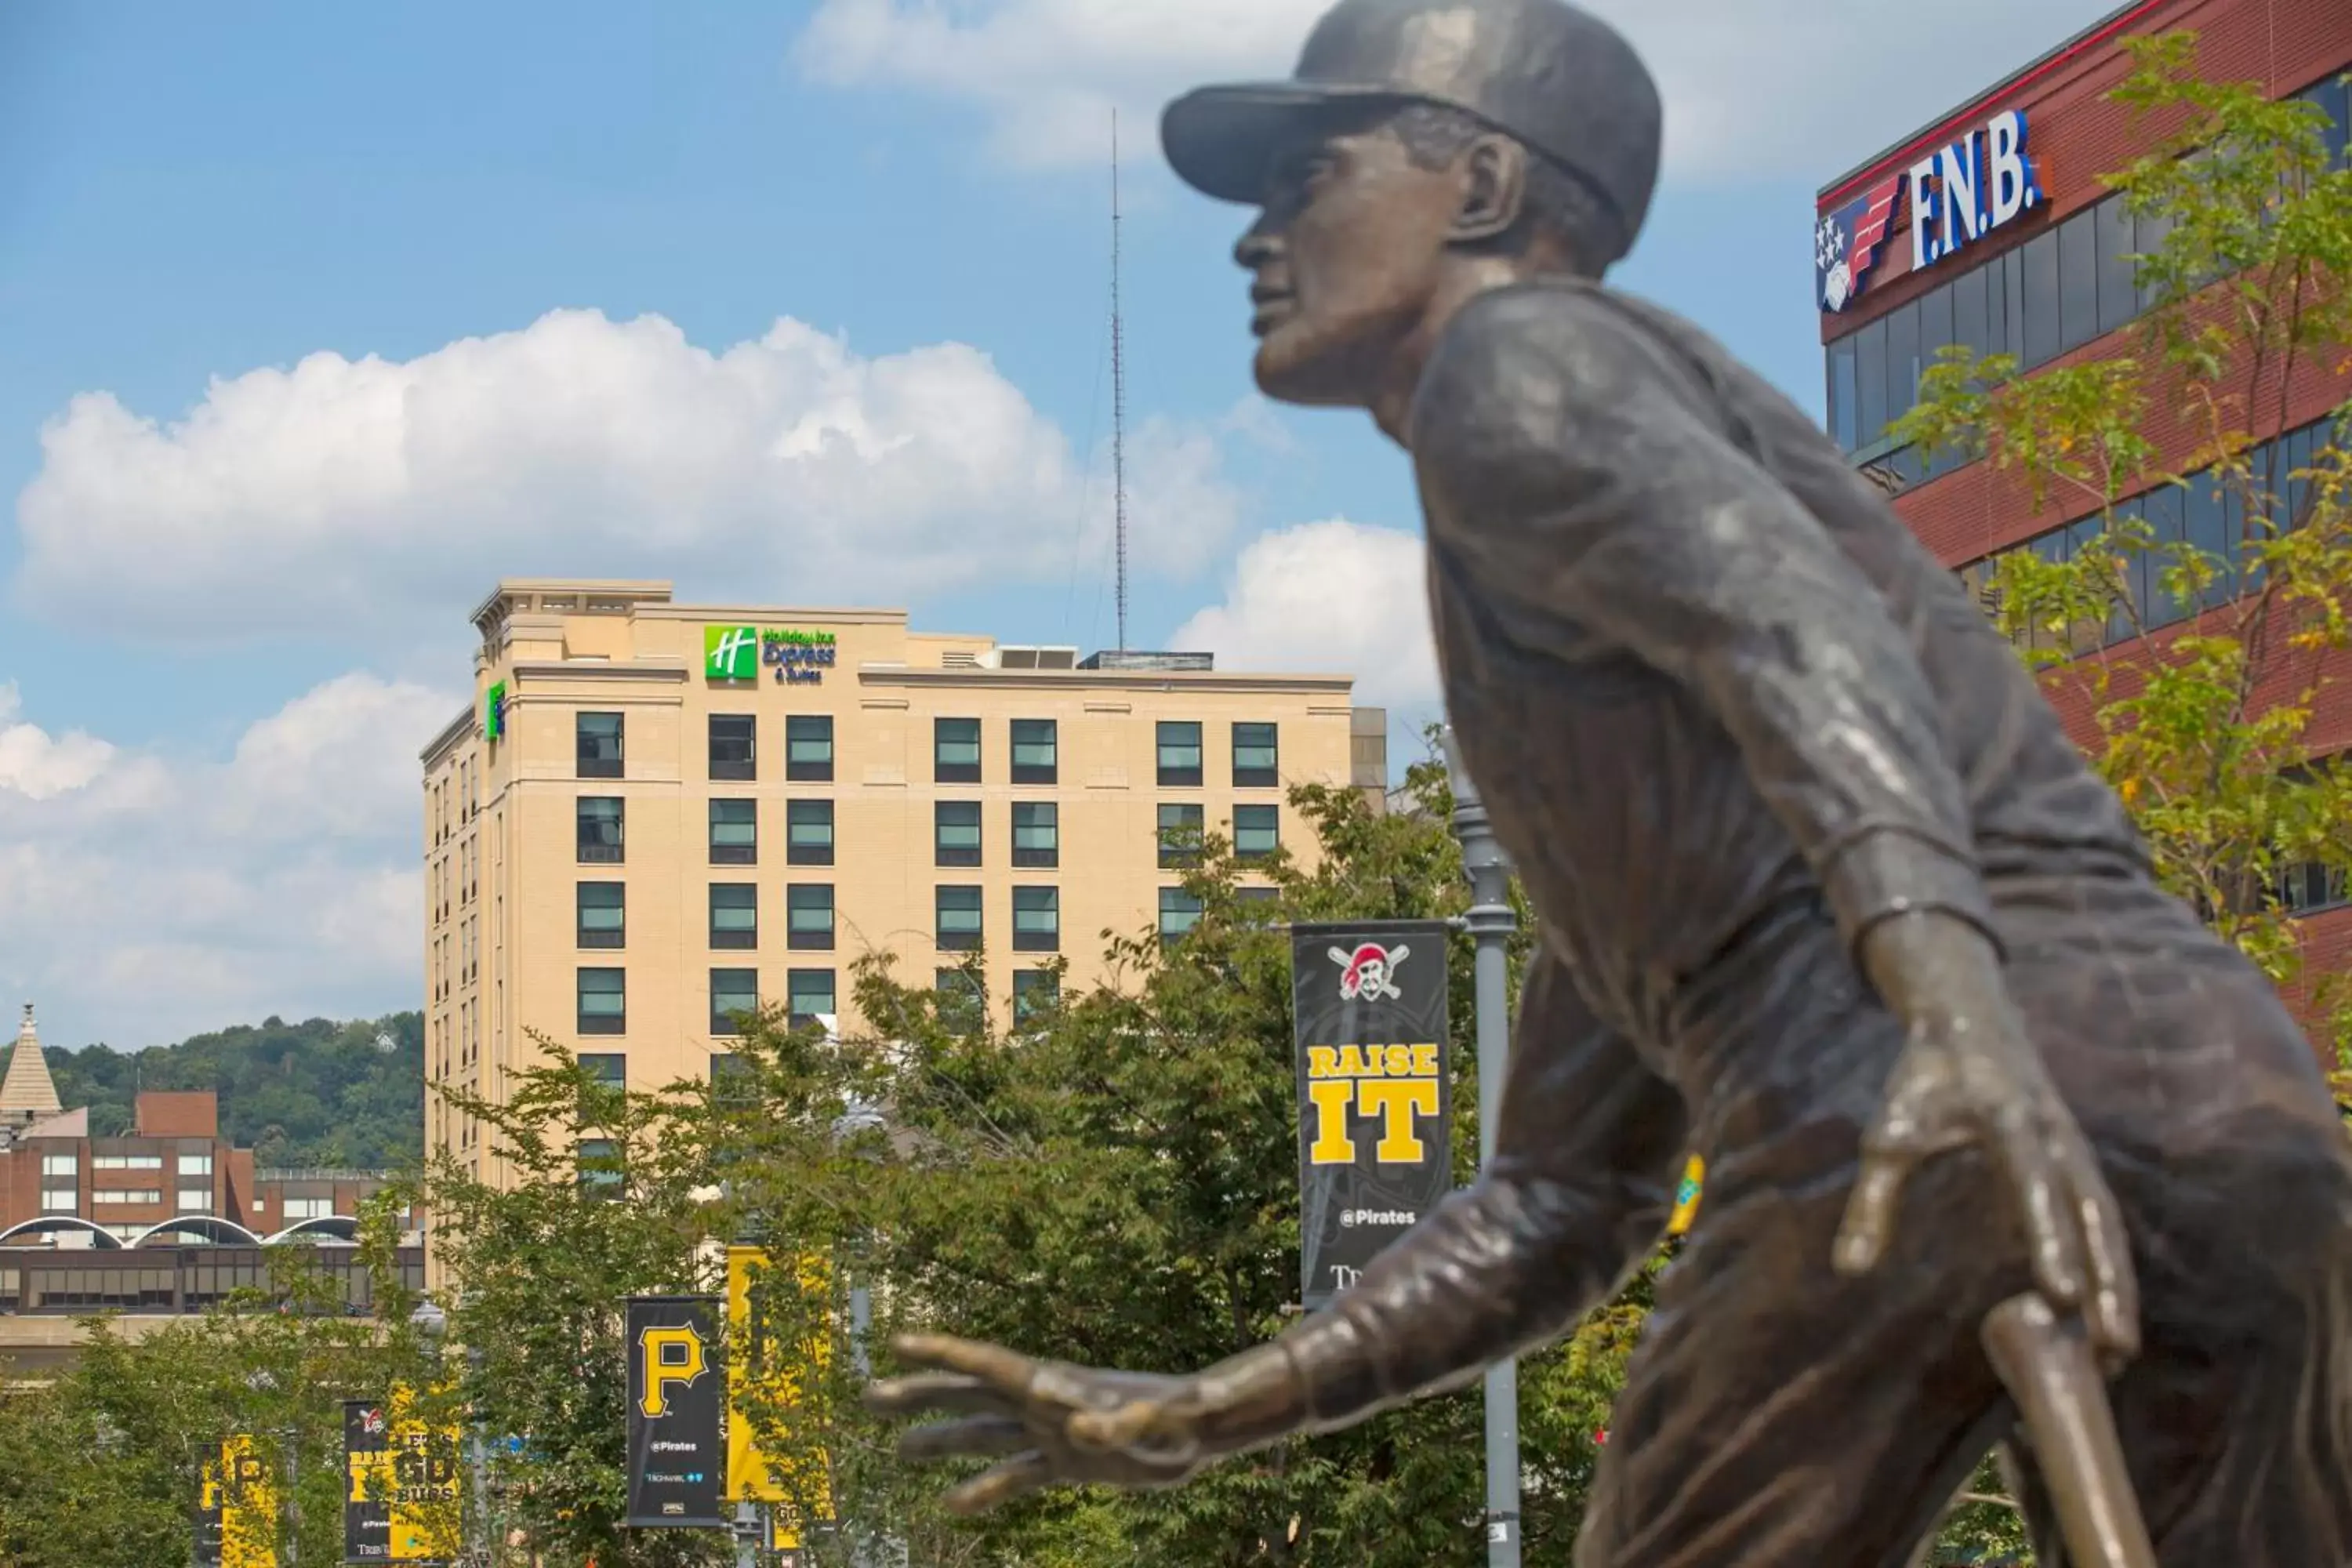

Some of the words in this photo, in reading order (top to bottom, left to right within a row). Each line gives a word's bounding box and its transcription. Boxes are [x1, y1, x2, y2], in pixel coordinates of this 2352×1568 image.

[1910, 110, 2043, 272] F.N.B.
[763, 643, 836, 666] Express
[1307, 1044, 1439, 1078] RAISE
[1308, 1079, 1440, 1164] IT
[1340, 1209, 1416, 1228] @Pirates
[638, 1320, 710, 1418] P
[650, 1441, 697, 1453] @Pirates
